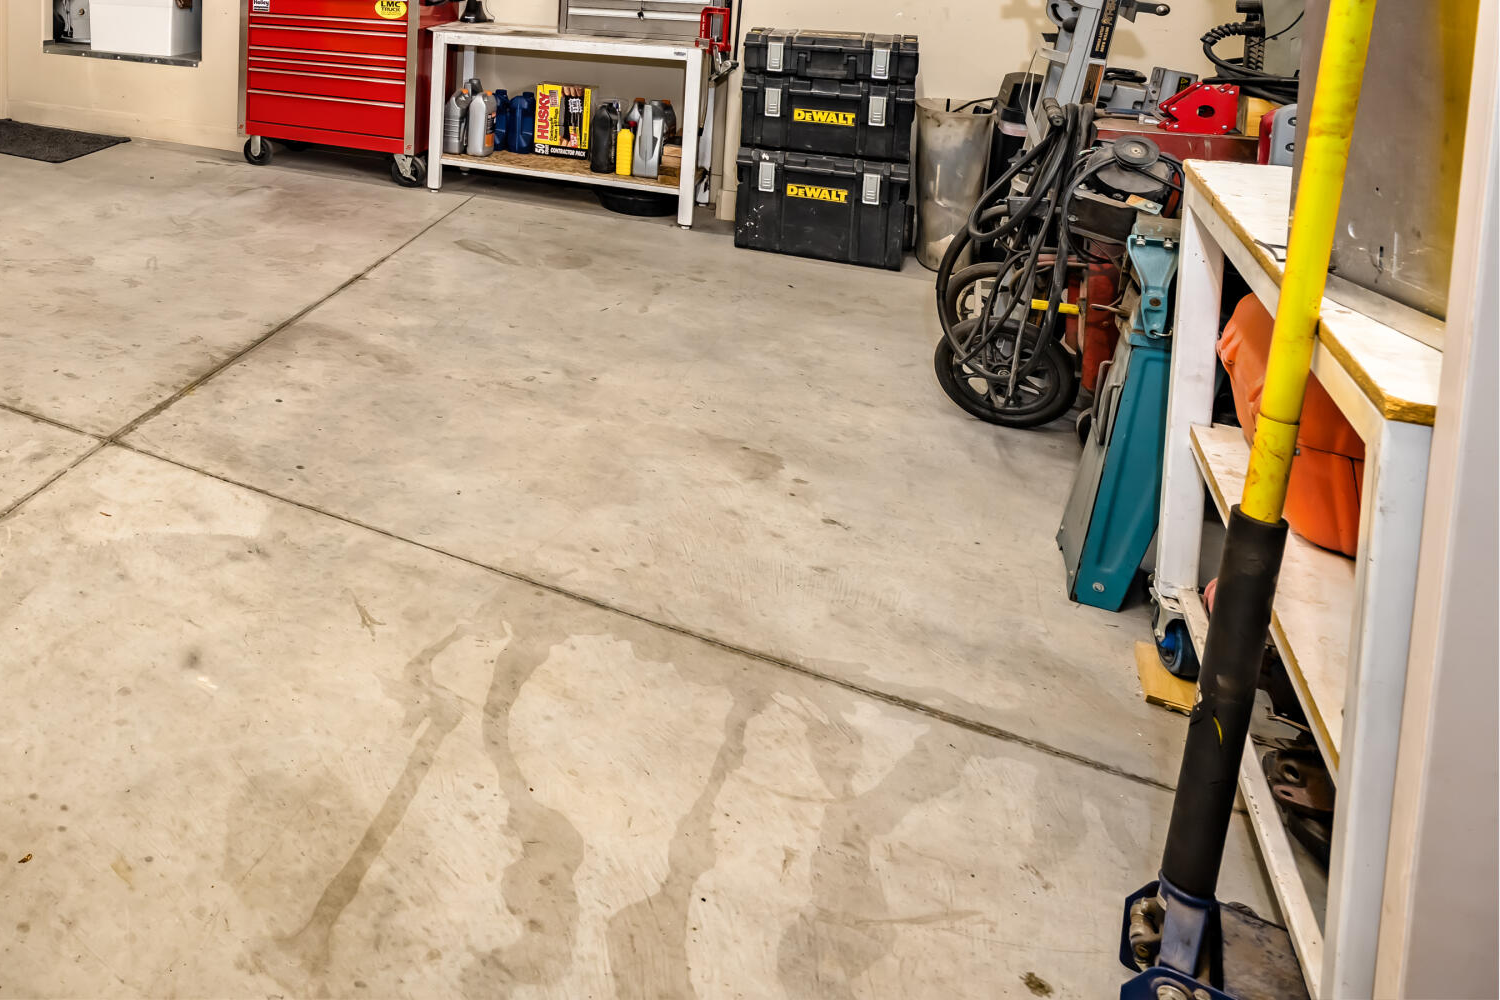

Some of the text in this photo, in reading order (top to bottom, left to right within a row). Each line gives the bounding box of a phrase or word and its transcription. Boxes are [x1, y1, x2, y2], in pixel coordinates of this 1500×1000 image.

[537, 92, 550, 139] HUSKY
[535, 144, 544, 153] 50
[550, 148, 574, 156] CONTRACTOR
